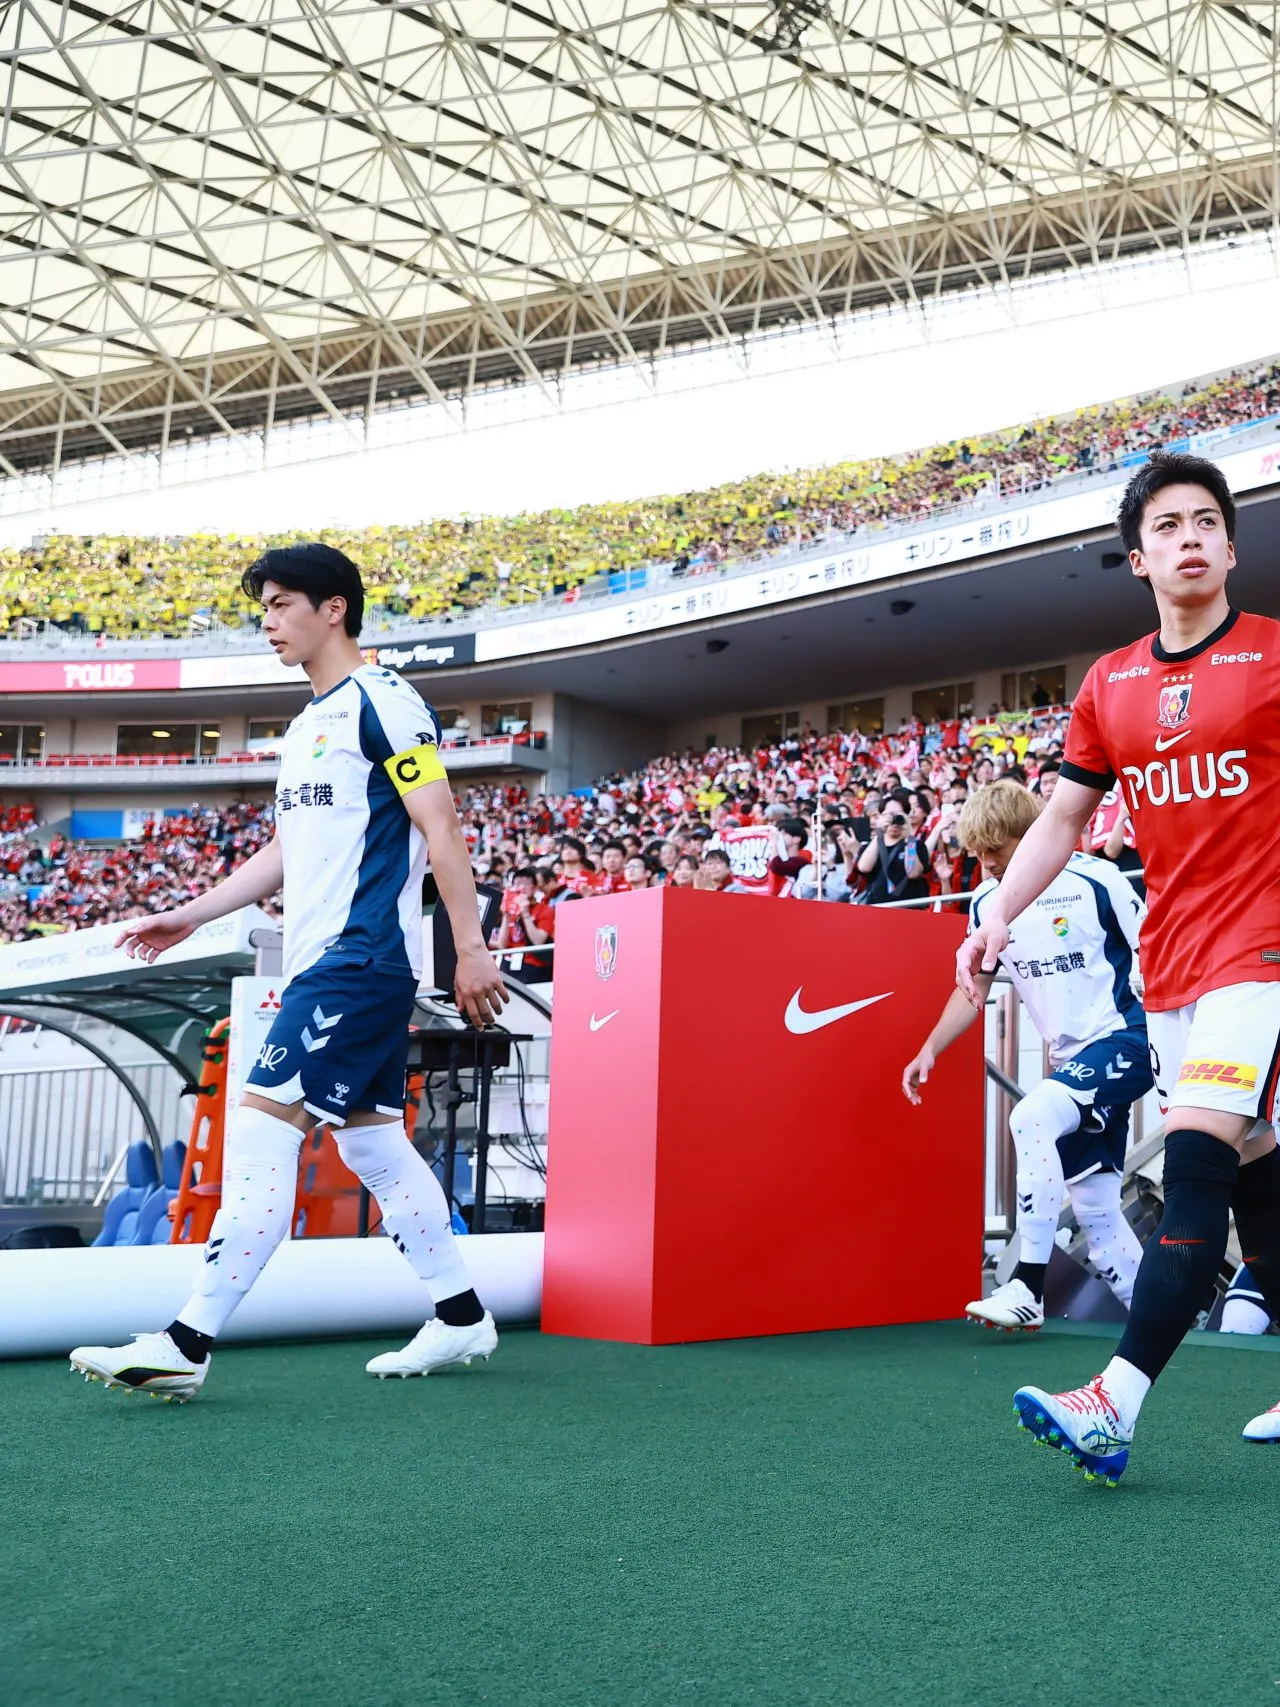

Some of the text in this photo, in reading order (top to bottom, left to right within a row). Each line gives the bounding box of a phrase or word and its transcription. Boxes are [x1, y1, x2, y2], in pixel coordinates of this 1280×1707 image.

[1210, 651, 1263, 666] EneCle
[64, 664, 135, 688] POLUS
[1107, 665, 1151, 684] EneCle
[396, 756, 421, 783] C
[1121, 749, 1250, 811] POLUS
[1036, 894, 1082, 907] FURUKAWA
[1180, 1063, 1242, 1084] DHL
